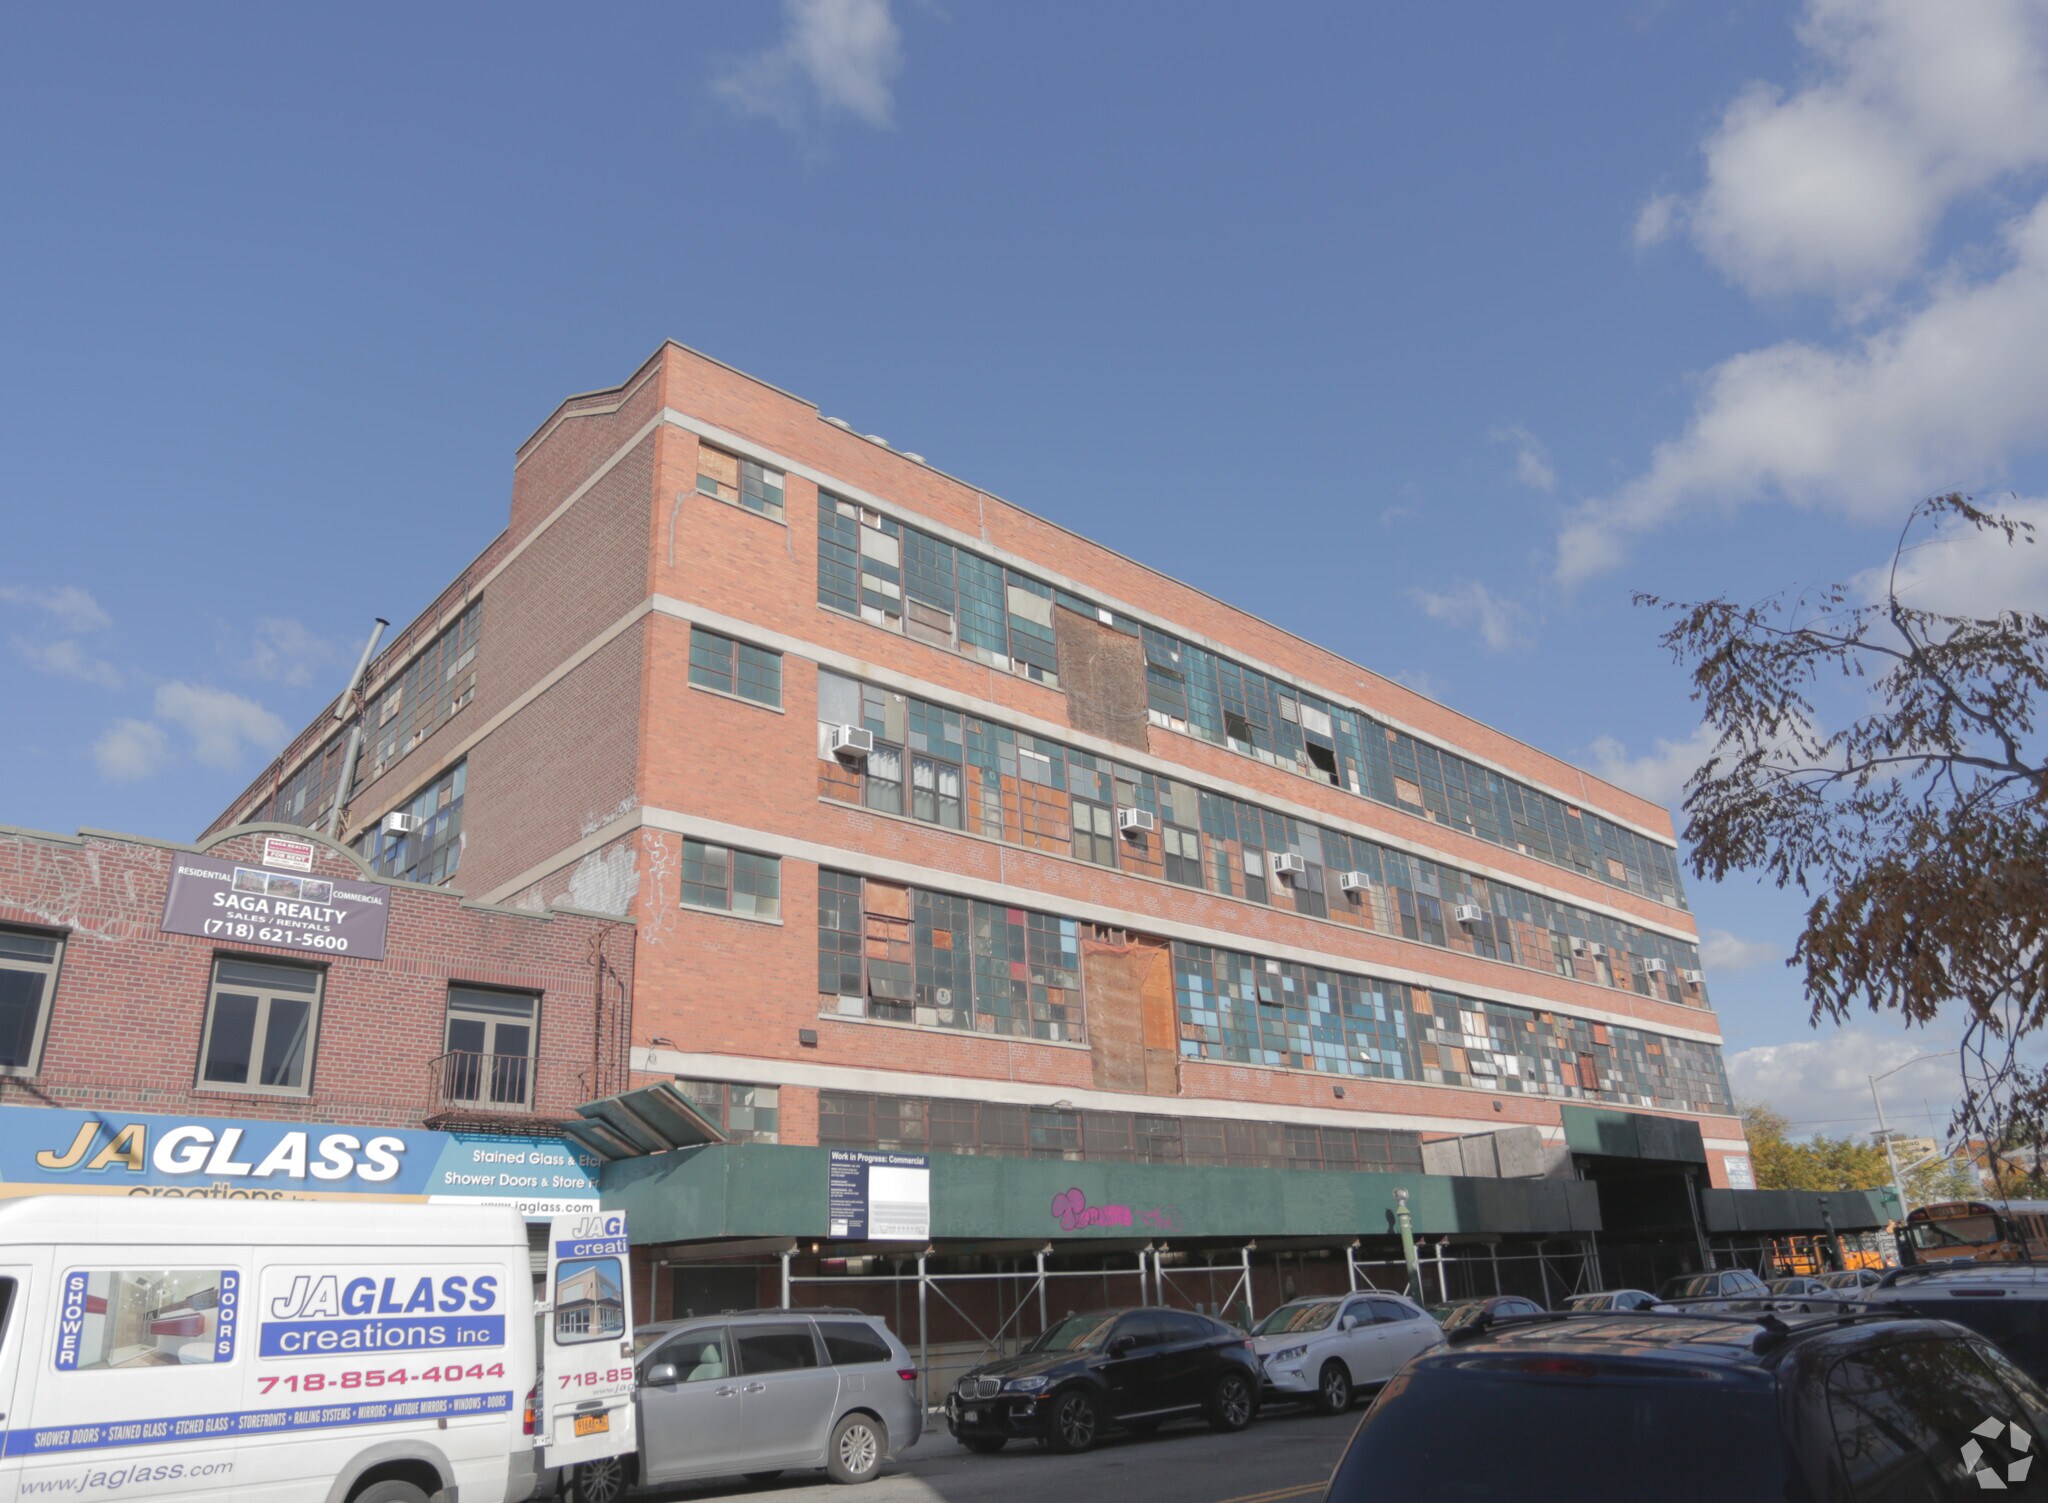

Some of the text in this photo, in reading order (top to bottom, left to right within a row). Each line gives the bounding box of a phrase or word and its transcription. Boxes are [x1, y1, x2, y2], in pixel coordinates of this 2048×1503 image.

[178, 866, 232, 882] RESIDENTIAL
[213, 892, 347, 924] SAGA REALTY
[333, 890, 383, 905] COMMERCIAL
[204, 918, 348, 950] (718) 621-5600
[226, 911, 266, 924] SALES
[276, 918, 331, 932] RENTALS
[473, 1150, 525, 1164] Stained
[529, 1152, 565, 1166] Glass
[568, 1157, 576, 1166] &
[831, 1151, 849, 1161] Work
[857, 1153, 888, 1164] Progress:
[889, 1155, 925, 1165] Commercial
[445, 1172, 496, 1186] Shower
[499, 1174, 538, 1187] Doors
[541, 1177, 549, 1187] &
[552, 1176, 585, 1189] Store
[271, 1275, 498, 1319] JAGLASS
[59, 1277, 84, 1365] SHOWER
[218, 1277, 236, 1355] DOORS
[279, 1322, 490, 1352] creations inc
[258, 1362, 505, 1395] 718-854-4044
[34, 1394, 506, 1448] SHOWER DOORS STAINED GLASS ETCHED GLASS STOREFRONTS RAILING SYSTEMS MIRRORS ANTIQUE MIRRORS WINDOWS DOORS
[21, 1461, 233, 1495] www.jaglass.com
